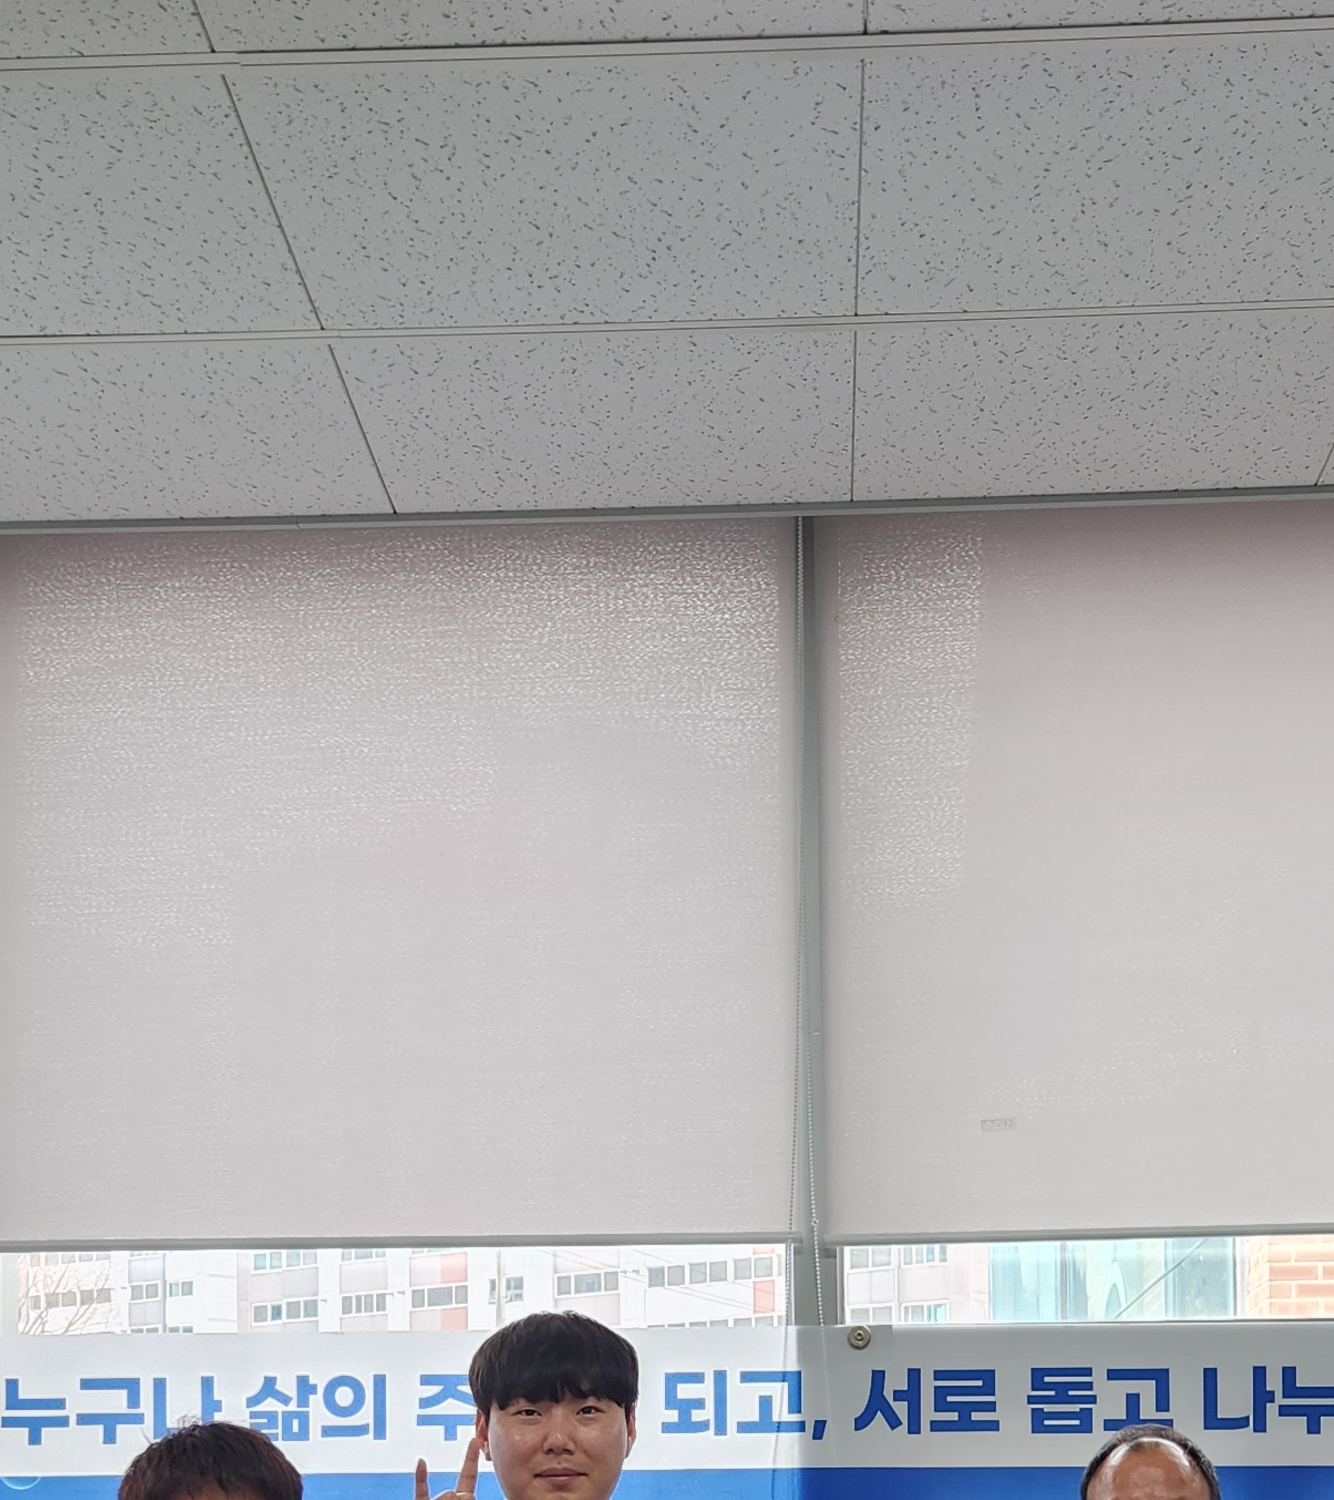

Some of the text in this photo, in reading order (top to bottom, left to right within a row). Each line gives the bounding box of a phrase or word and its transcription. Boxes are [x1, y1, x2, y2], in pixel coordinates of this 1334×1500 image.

[245, 1373, 387, 1442] 삶의
[661, 1369, 828, 1441] 되고,
[853, 1367, 1001, 1435] 서로
[1026, 1366, 1175, 1434] 돕고
